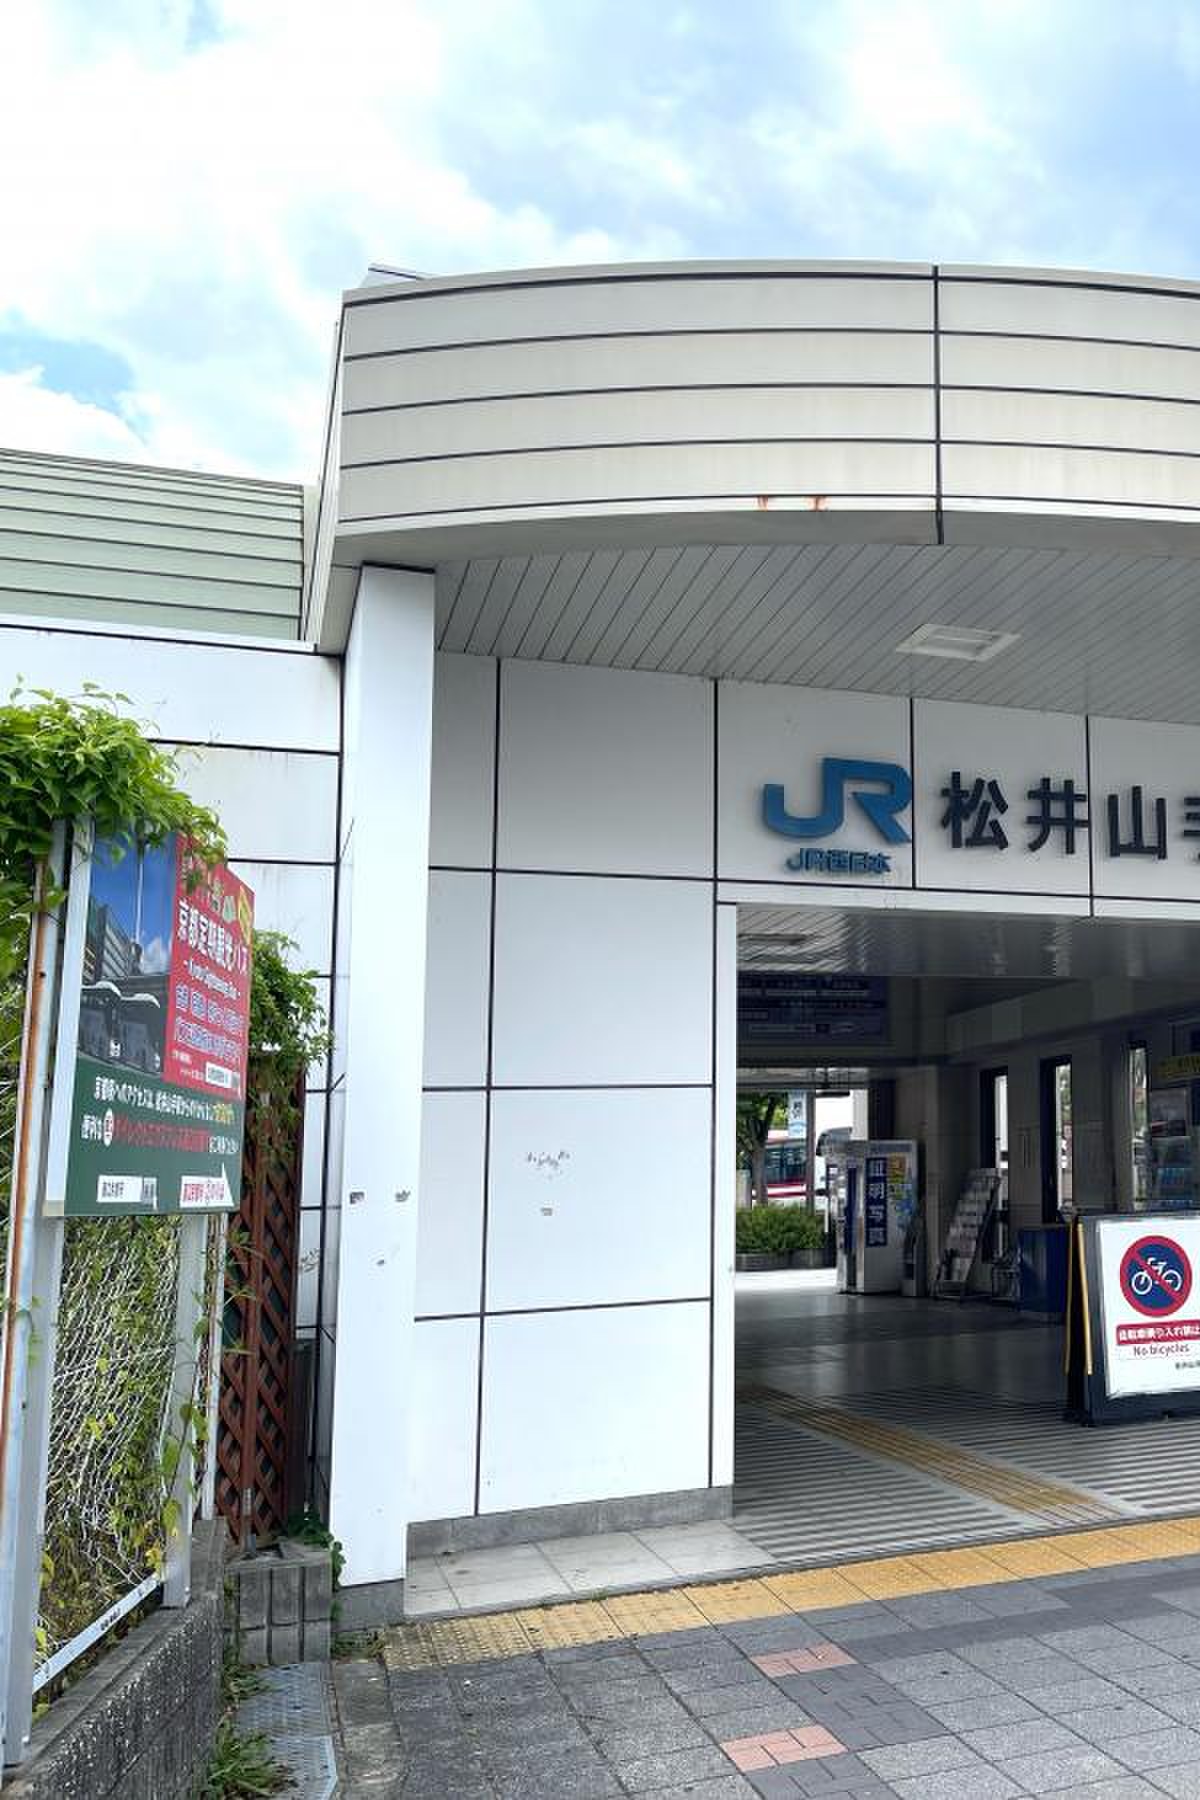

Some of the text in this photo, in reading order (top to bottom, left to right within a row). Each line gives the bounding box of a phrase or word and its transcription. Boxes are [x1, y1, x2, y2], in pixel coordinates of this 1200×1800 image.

[763, 757, 912, 844] JR
[786, 848, 892, 874] JR西日本
[1133, 1343, 1190, 1357] No bicycles
